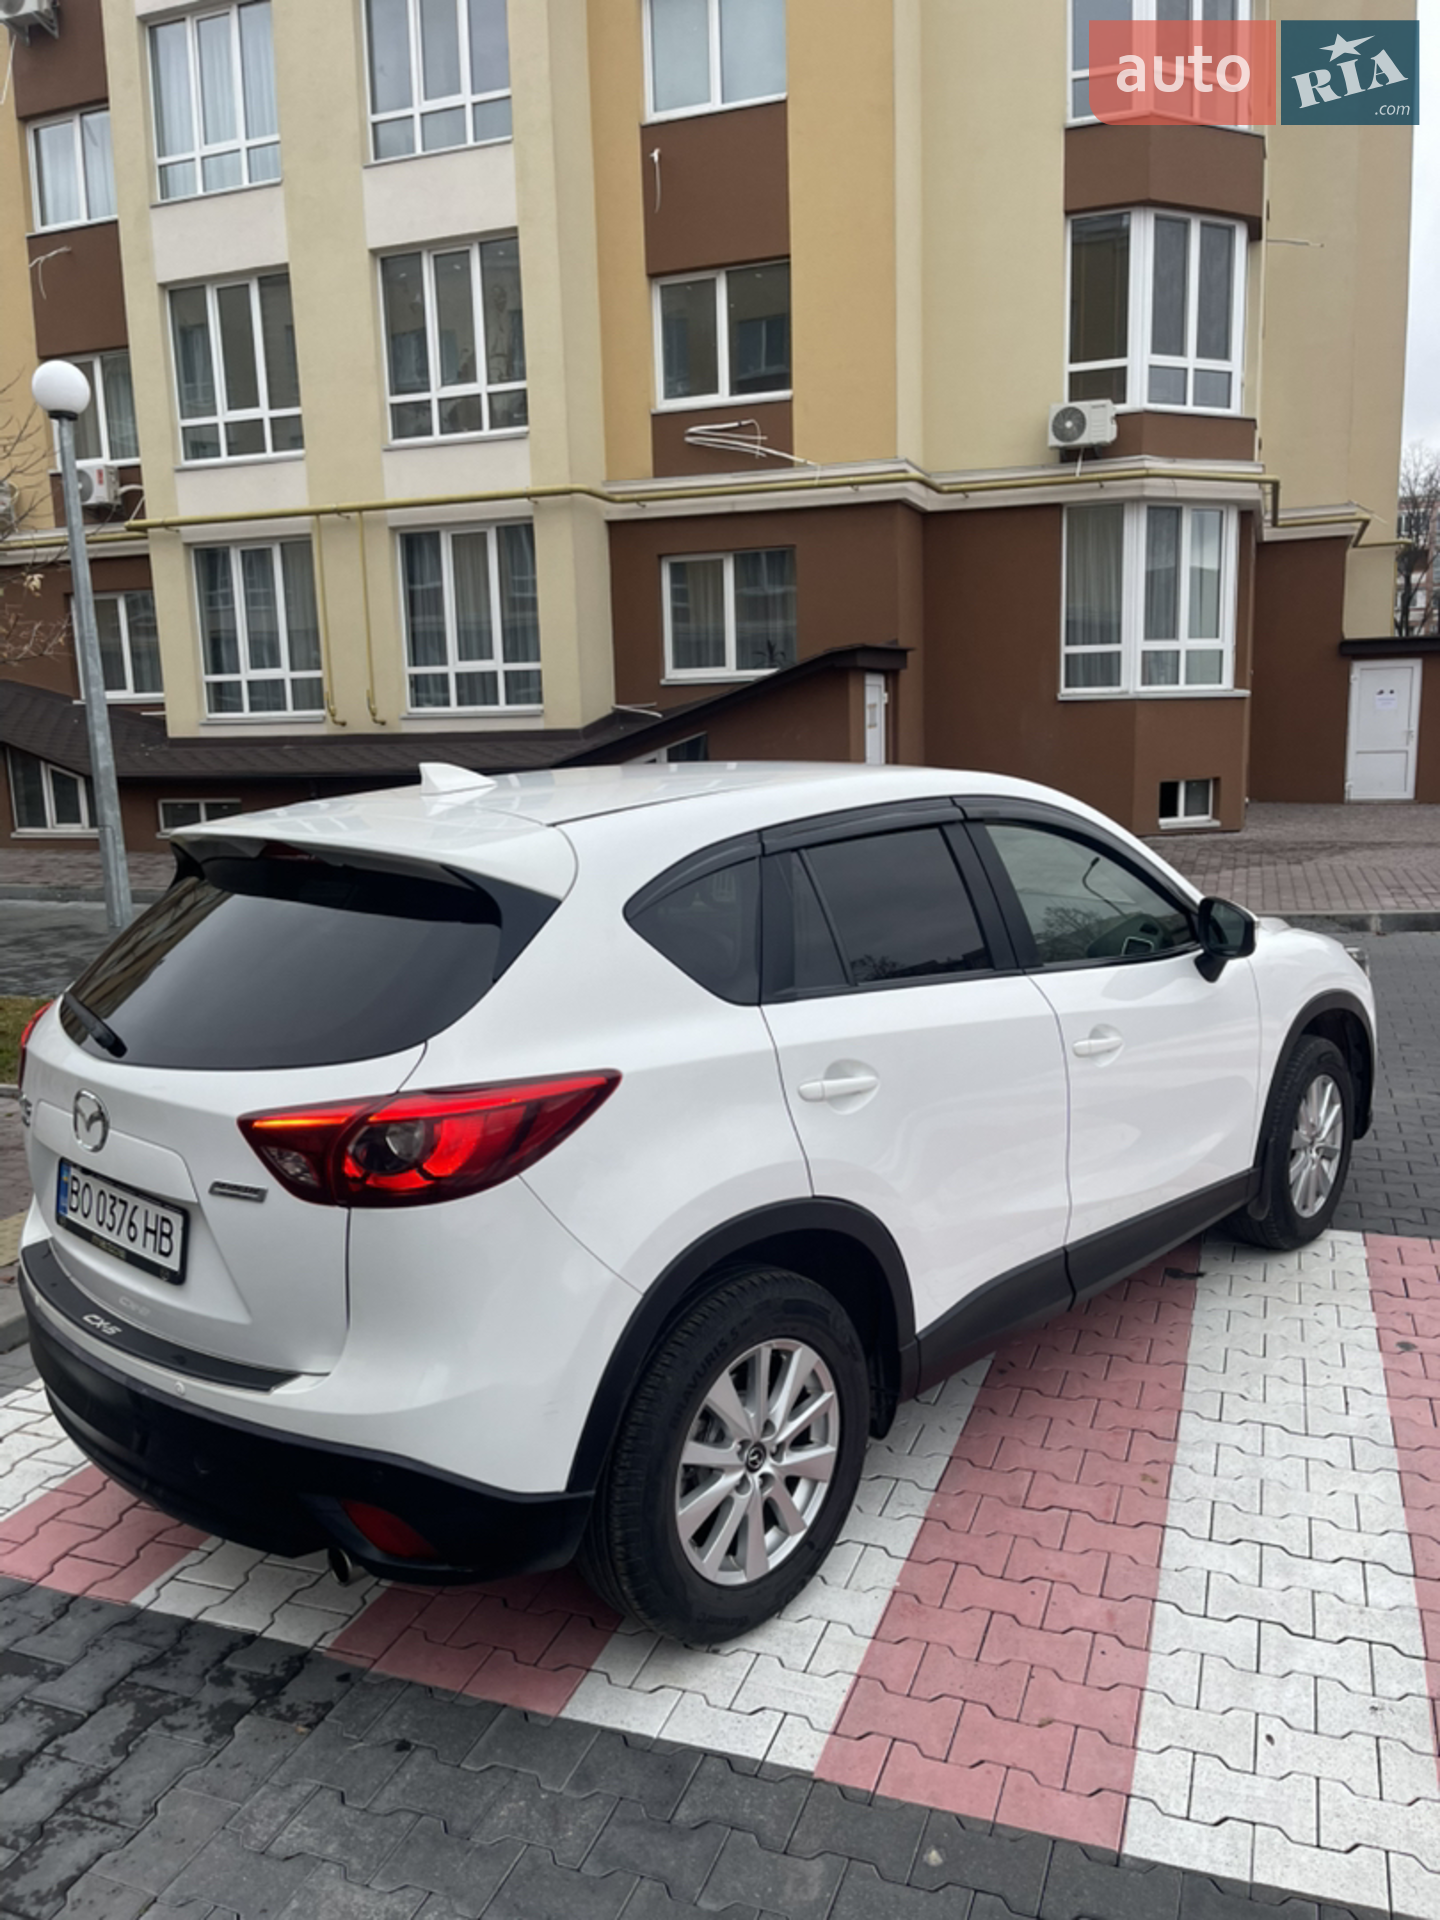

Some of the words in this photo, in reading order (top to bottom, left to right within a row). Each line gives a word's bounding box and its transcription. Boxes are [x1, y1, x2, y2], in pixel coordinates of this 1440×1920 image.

[68, 1176, 93, 1219] BO
[96, 1190, 138, 1243] 0376
[142, 1209, 174, 1258] HB
[83, 1313, 122, 1336] CX-5
